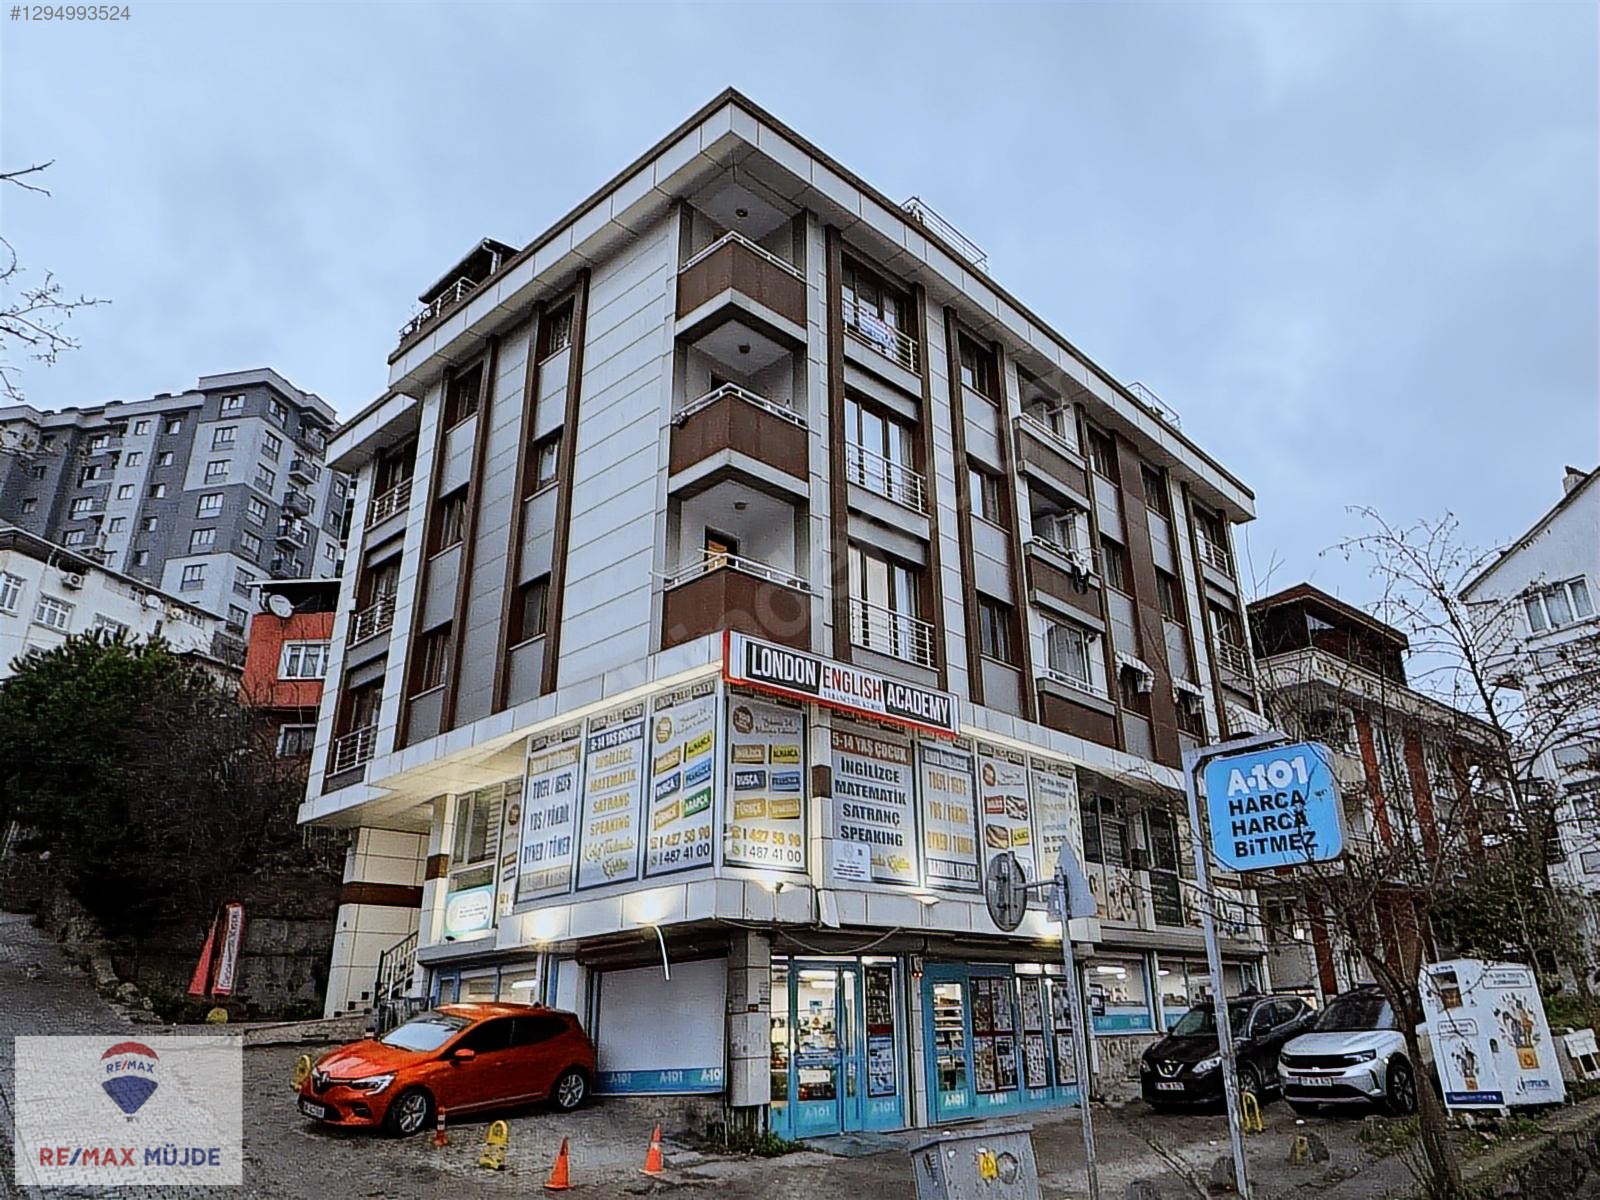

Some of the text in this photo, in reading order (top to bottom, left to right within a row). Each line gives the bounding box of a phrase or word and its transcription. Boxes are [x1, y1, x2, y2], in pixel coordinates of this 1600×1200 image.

[751, 644, 817, 687] LONDON
[823, 665, 882, 702] ENGLISH
[886, 683, 949, 724] ACADEMY
[832, 732, 854, 750] 5-14
[855, 736, 874, 757] YAŞ
[874, 741, 907, 761] ÇOCUK
[841, 756, 901, 783] İNGİLİZCE
[835, 779, 907, 805] MATEMATİK
[1228, 790, 1306, 817] HARCA
[842, 803, 901, 828] SATRANÇ
[1231, 810, 1309, 837] HARCA
[840, 825, 903, 847] SPEAKING
[664, 842, 710, 864] 487 41 00
[749, 845, 802, 863] 487 41 00
